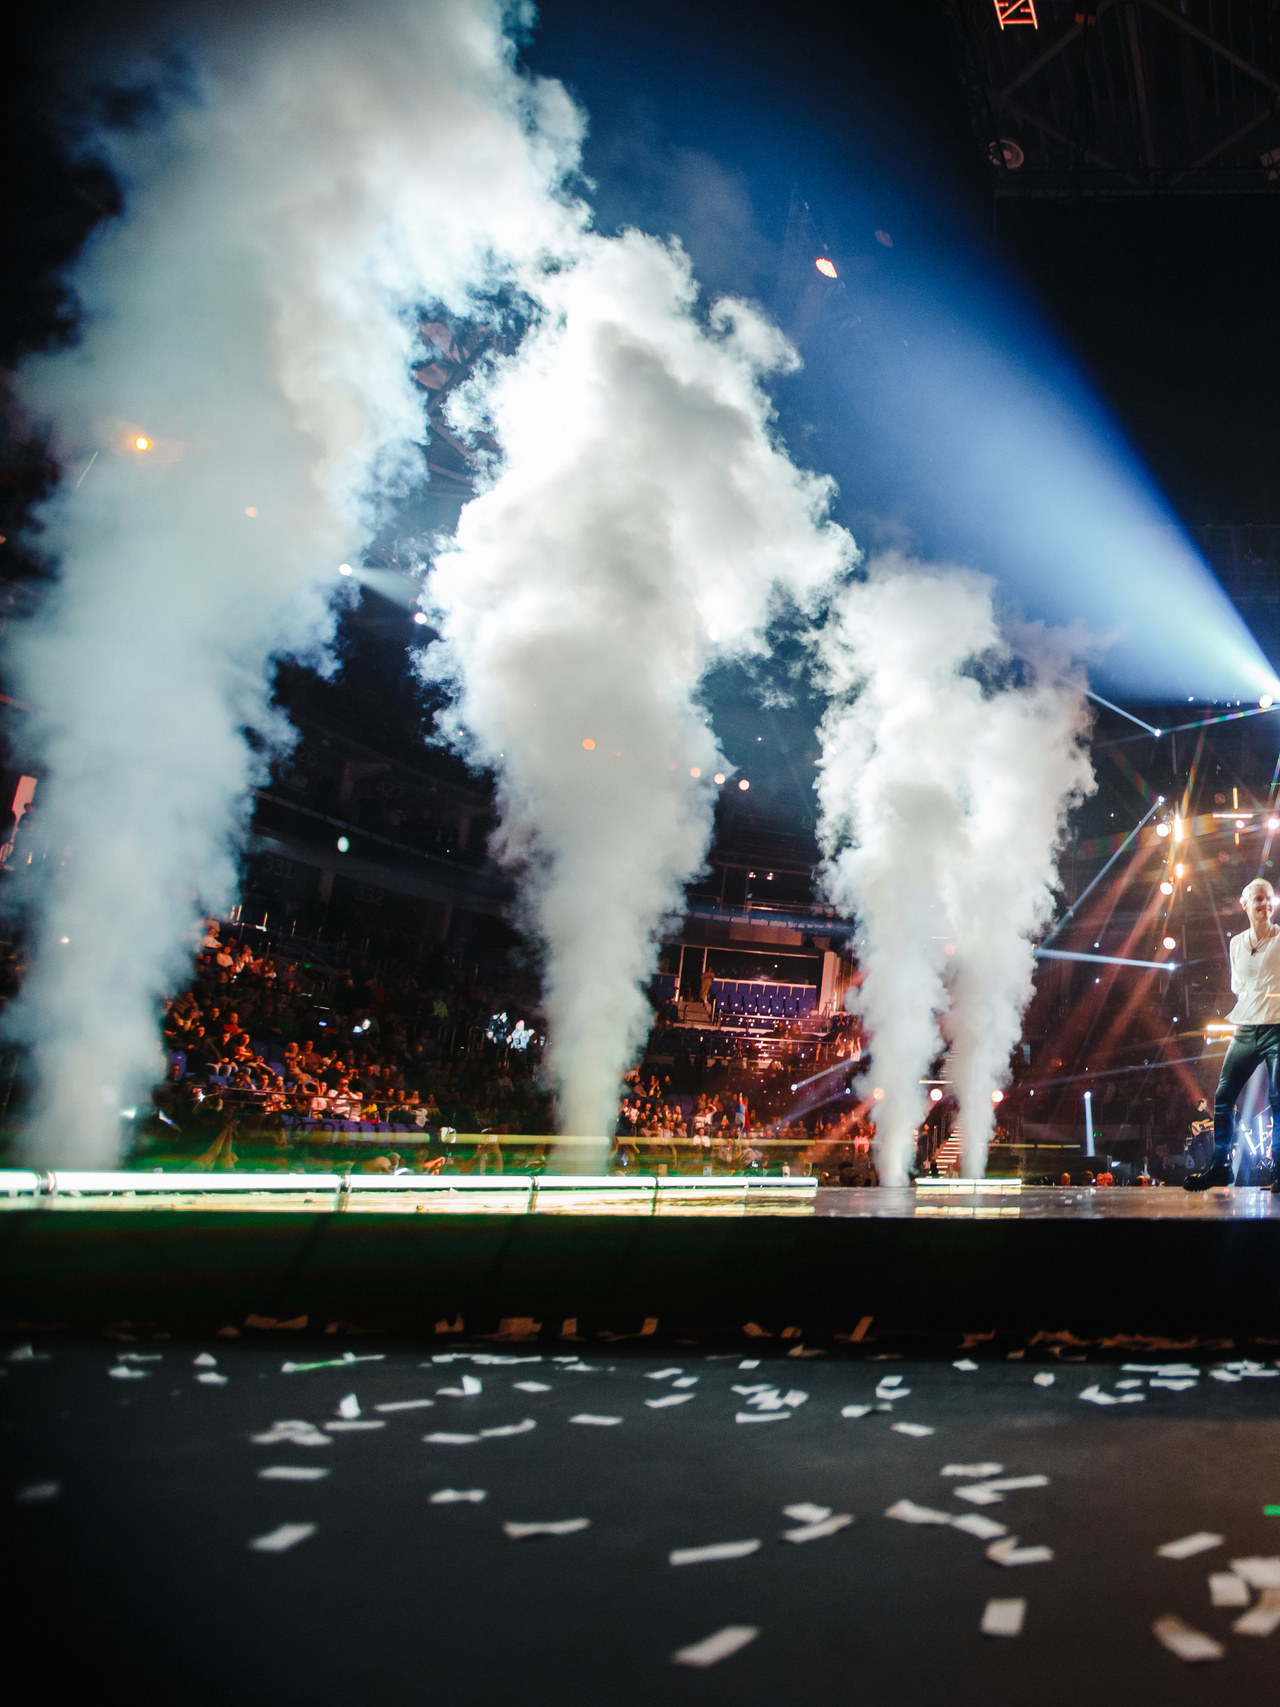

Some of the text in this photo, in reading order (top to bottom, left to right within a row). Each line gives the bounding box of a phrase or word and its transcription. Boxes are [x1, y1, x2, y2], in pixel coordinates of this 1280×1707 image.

[376, 780, 404, 799] 427
[262, 855, 293, 879] 331
[354, 884, 385, 905] 332
